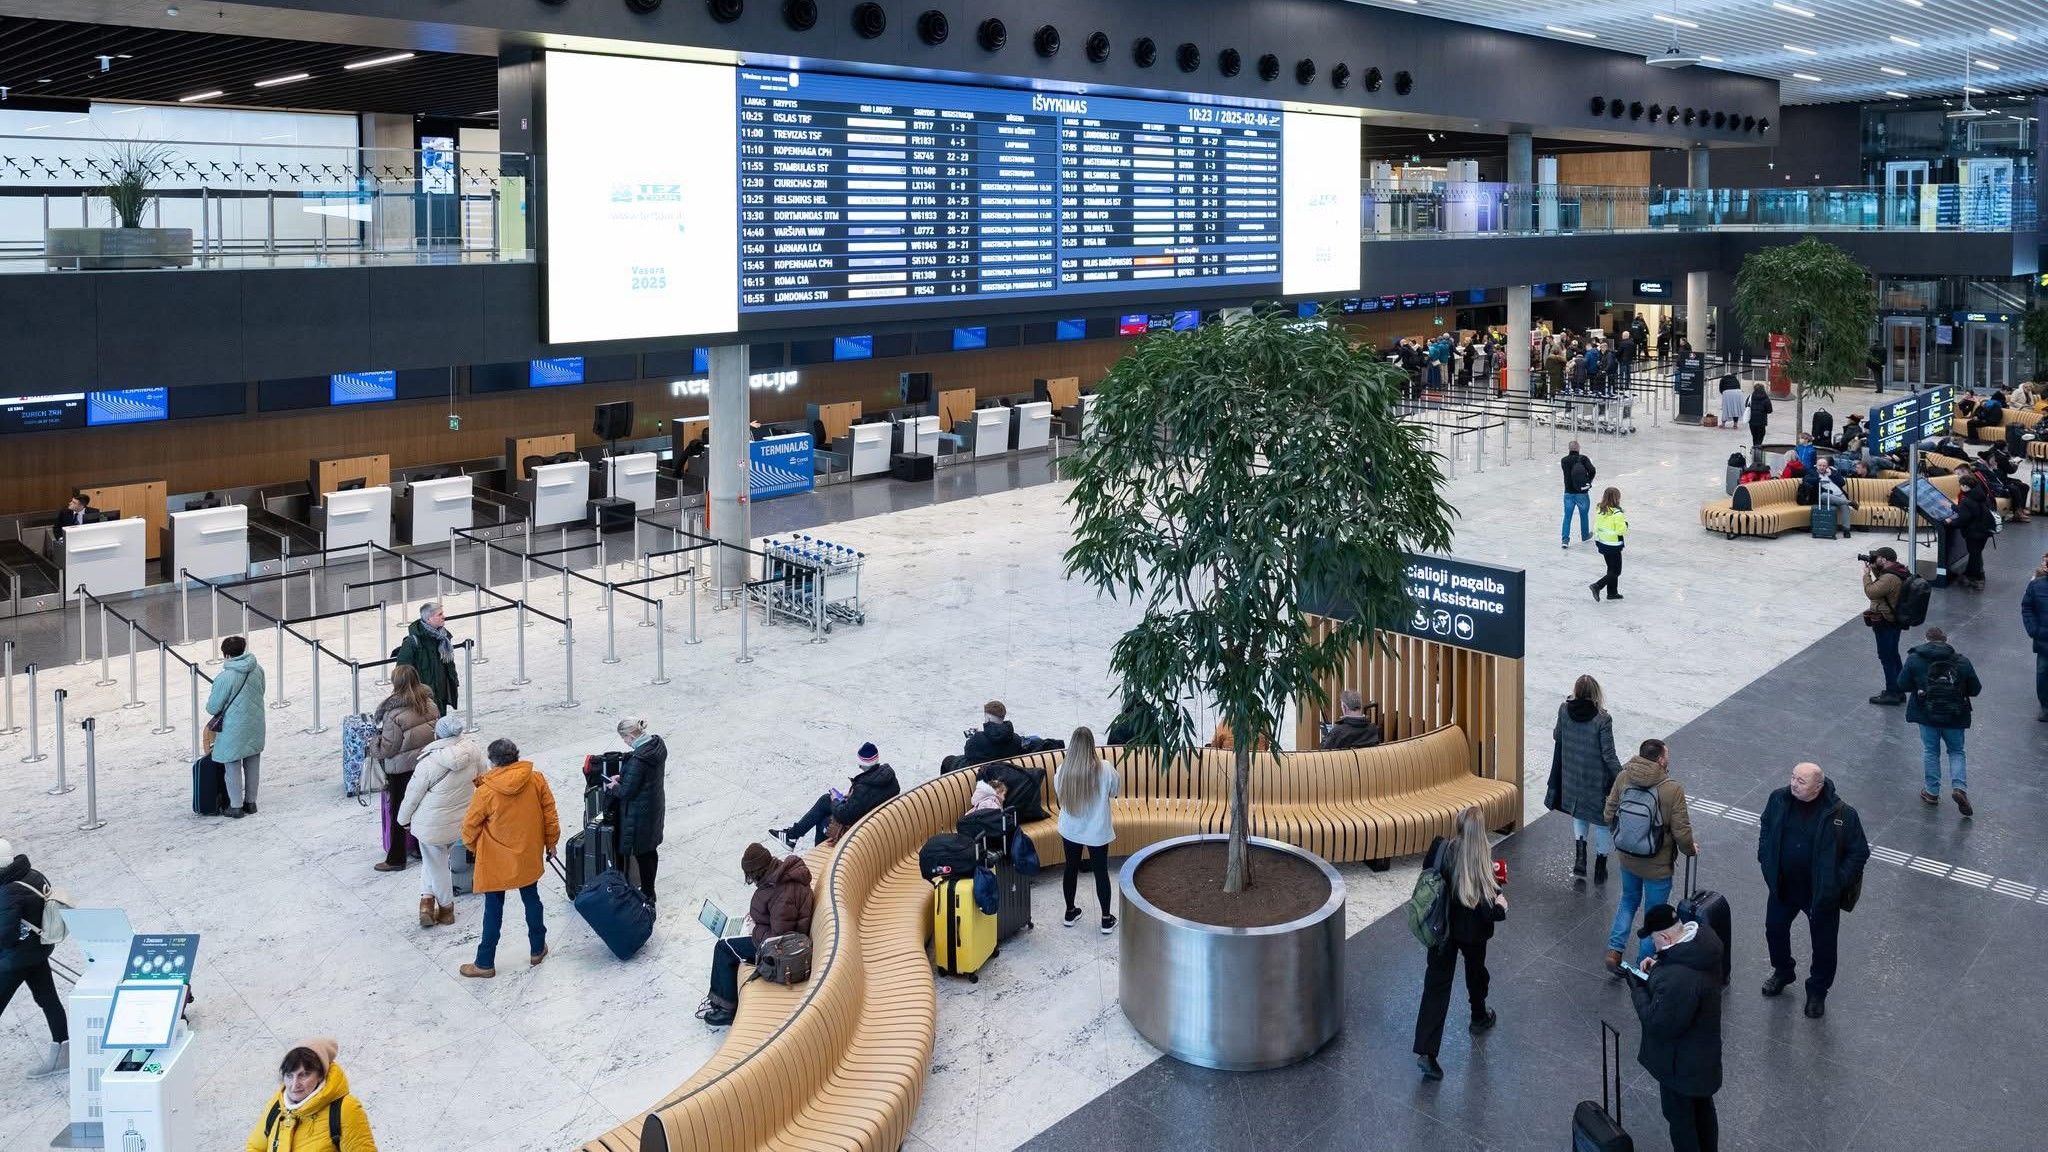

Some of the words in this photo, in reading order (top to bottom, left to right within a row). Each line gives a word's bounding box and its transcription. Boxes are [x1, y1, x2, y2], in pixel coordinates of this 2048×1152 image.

[1032, 93, 1087, 114] IŠVYKIMAS
[742, 111, 763, 121] 10:25
[773, 113, 796, 123] OSLAS
[798, 114, 812, 124] TRF
[951, 124, 955, 132] 1
[961, 124, 965, 132] 3
[1189, 108, 1212, 121] 10:23
[1221, 111, 1268, 126] 2025-02-04
[742, 128, 763, 138] 11:00
[773, 130, 807, 139] TREVIZAS
[808, 131, 822, 140] TSF
[951, 138, 955, 147] 4
[961, 138, 965, 147] 5
[742, 145, 763, 154] 11:10
[773, 146, 816, 156] KOPENHAGA
[818, 148, 832, 157] CPH
[742, 161, 763, 170] 11:55
[773, 162, 816, 172] STAMBULAS
[817, 163, 829, 172] IST
[638, 184, 680, 193] TEZ
[743, 178, 764, 187] 12:30
[774, 179, 812, 188] CIURICHAS
[813, 179, 827, 188] ZRH
[951, 182, 955, 190] 6
[961, 182, 965, 190] 8
[743, 195, 764, 204] 13:25
[774, 195, 812, 204] HELSINKIS
[813, 195, 828, 204] HEL
[743, 211, 764, 220] 13:30
[774, 211, 822, 220] DORTMUNDAS
[824, 211, 839, 220] DTM
[743, 228, 764, 237] 14:40
[774, 226, 806, 236] VARŠUVA
[807, 228, 825, 236] WAW
[743, 245, 764, 253] 15:40
[774, 244, 808, 253] LARNAKA
[809, 244, 822, 252] LCA
[632, 266, 665, 274] Vasara
[743, 261, 764, 270] 15:45
[774, 259, 817, 269] KOPENHAGA
[819, 259, 833, 268] CPH
[632, 277, 666, 289] 2025
[743, 278, 765, 287] 16:15
[775, 276, 796, 286] ROMA
[797, 276, 809, 285] CIA
[951, 270, 955, 278] 4
[961, 270, 965, 278] 5
[743, 294, 765, 303] 16:55
[775, 291, 813, 302] LONDONAS
[814, 291, 828, 300] STN
[951, 284, 955, 293] 8
[961, 284, 965, 293] 9
[761, 441, 808, 456] TERMINALAS
[1408, 565, 1448, 586] cialioji
[1451, 575, 1504, 594] pagalba
[1432, 588, 1504, 614] Assistance
